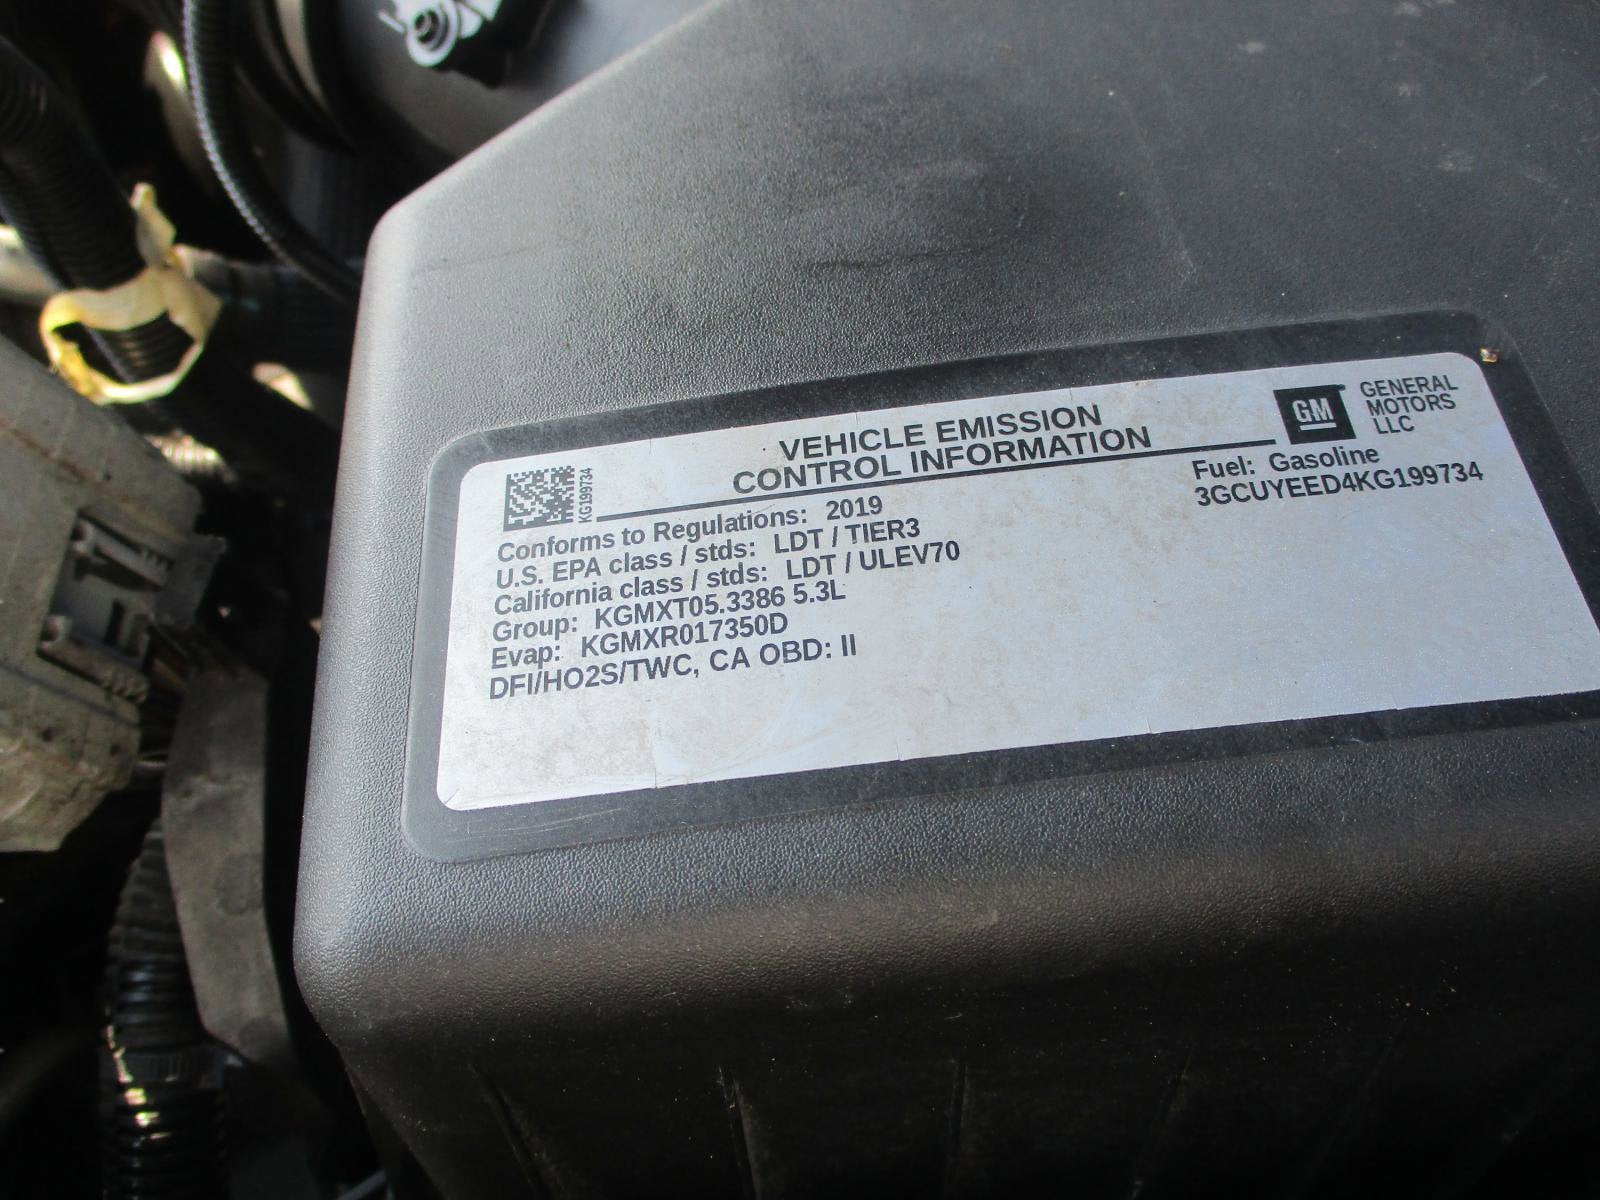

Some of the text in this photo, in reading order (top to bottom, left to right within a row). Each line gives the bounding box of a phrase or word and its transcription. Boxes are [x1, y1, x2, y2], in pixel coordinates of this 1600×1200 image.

[1293, 398, 1334, 423] GM
[1359, 375, 1458, 398] GENERAL
[1368, 394, 1456, 416] MOTORS
[779, 404, 1103, 462] VEHICLE EMISSION
[1373, 415, 1414, 434] LLC
[733, 426, 1152, 494] CONTROL INFORMATION
[1193, 446, 1380, 480] Fuel: Gasoline
[1194, 461, 1484, 507] 3GCUYEED4KG199734
[578, 467, 593, 522] KG199734
[497, 518, 921, 589] U.S. EPA class / stds: LDT / TIER3
[498, 496, 883, 562] Conforms to Regulations: 2019
[495, 541, 960, 615] California class / stds: LDT / ULEV70
[493, 580, 846, 642] Group: KGMXT05.3386 5.3L
[492, 613, 788, 669] Evap: KGMXR017350D
[709, 648, 751, 672] CA
[760, 638, 831, 666] OBD:
